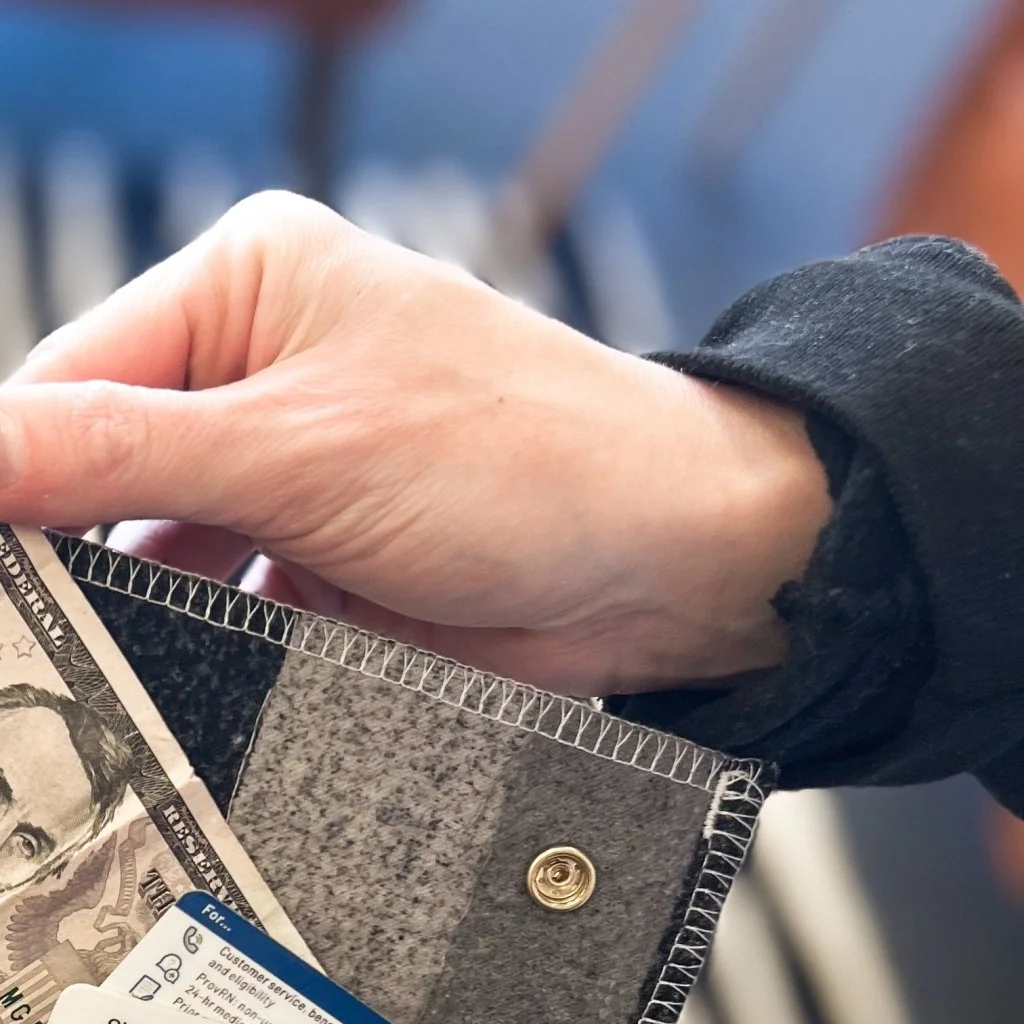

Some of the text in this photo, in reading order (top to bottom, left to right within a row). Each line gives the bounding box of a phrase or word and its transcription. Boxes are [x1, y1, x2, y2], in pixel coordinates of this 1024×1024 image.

[185, 985, 216, 1008] 24-hr
[208, 958, 277, 1009] and eligibility
[219, 946, 271, 985] Customer
[267, 981, 307, 1013] service,
